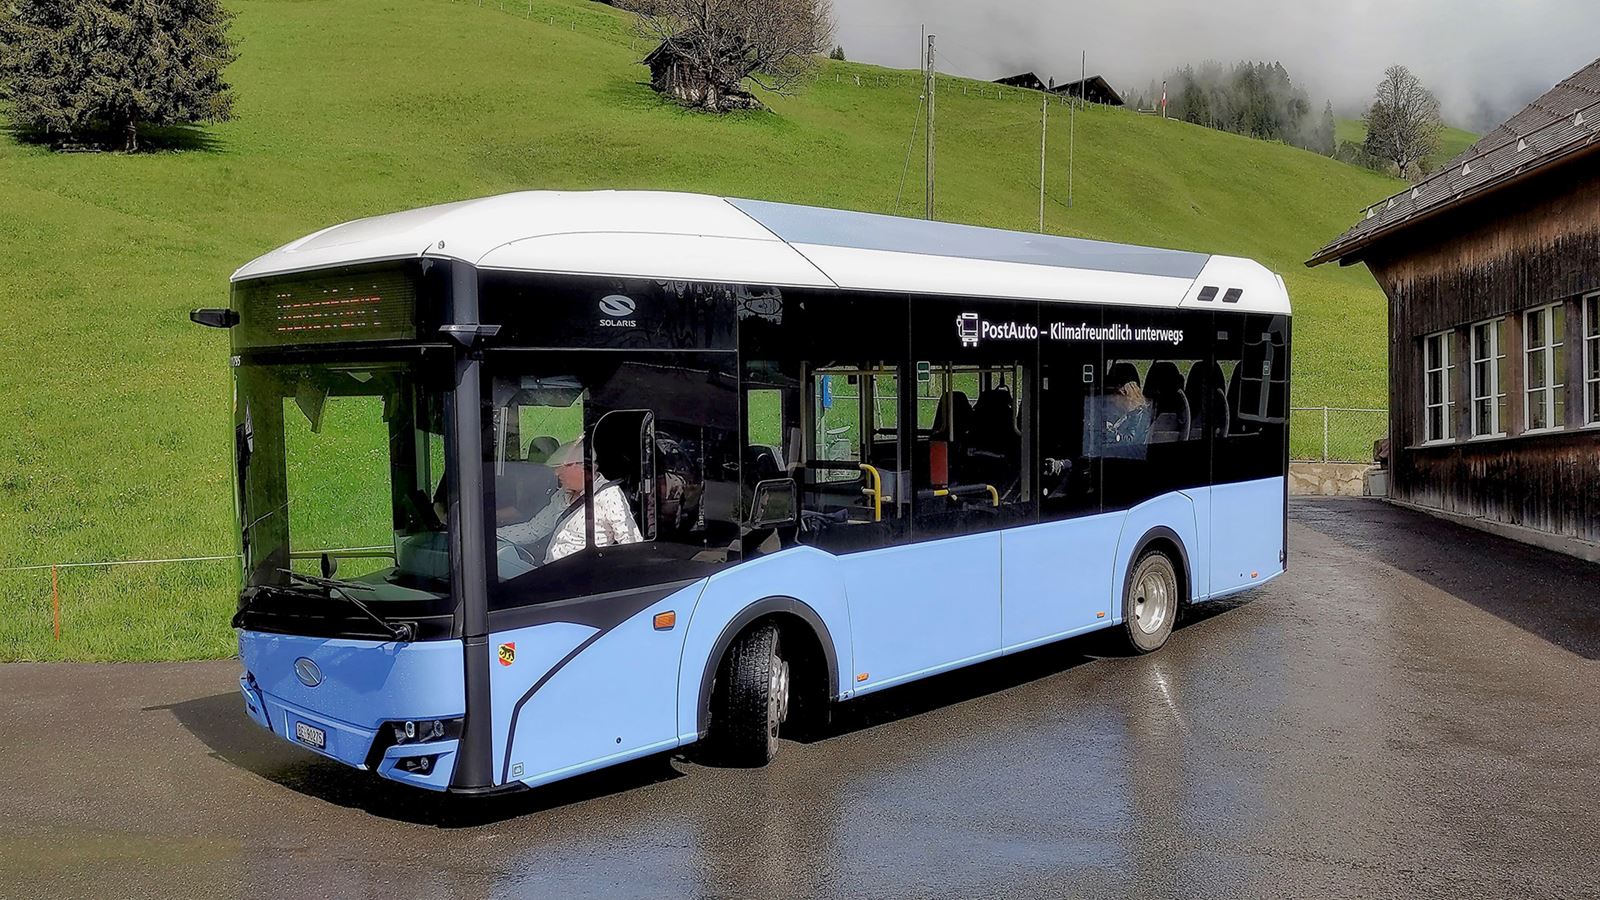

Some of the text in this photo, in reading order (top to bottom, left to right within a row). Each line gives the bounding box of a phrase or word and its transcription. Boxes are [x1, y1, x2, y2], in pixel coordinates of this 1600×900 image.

[599, 319, 636, 327] SOLARIS
[981, 321, 1038, 339] PostAuto
[1050, 322, 1132, 340] Klimafreundlich
[1134, 327, 1184, 345] unterwegs
